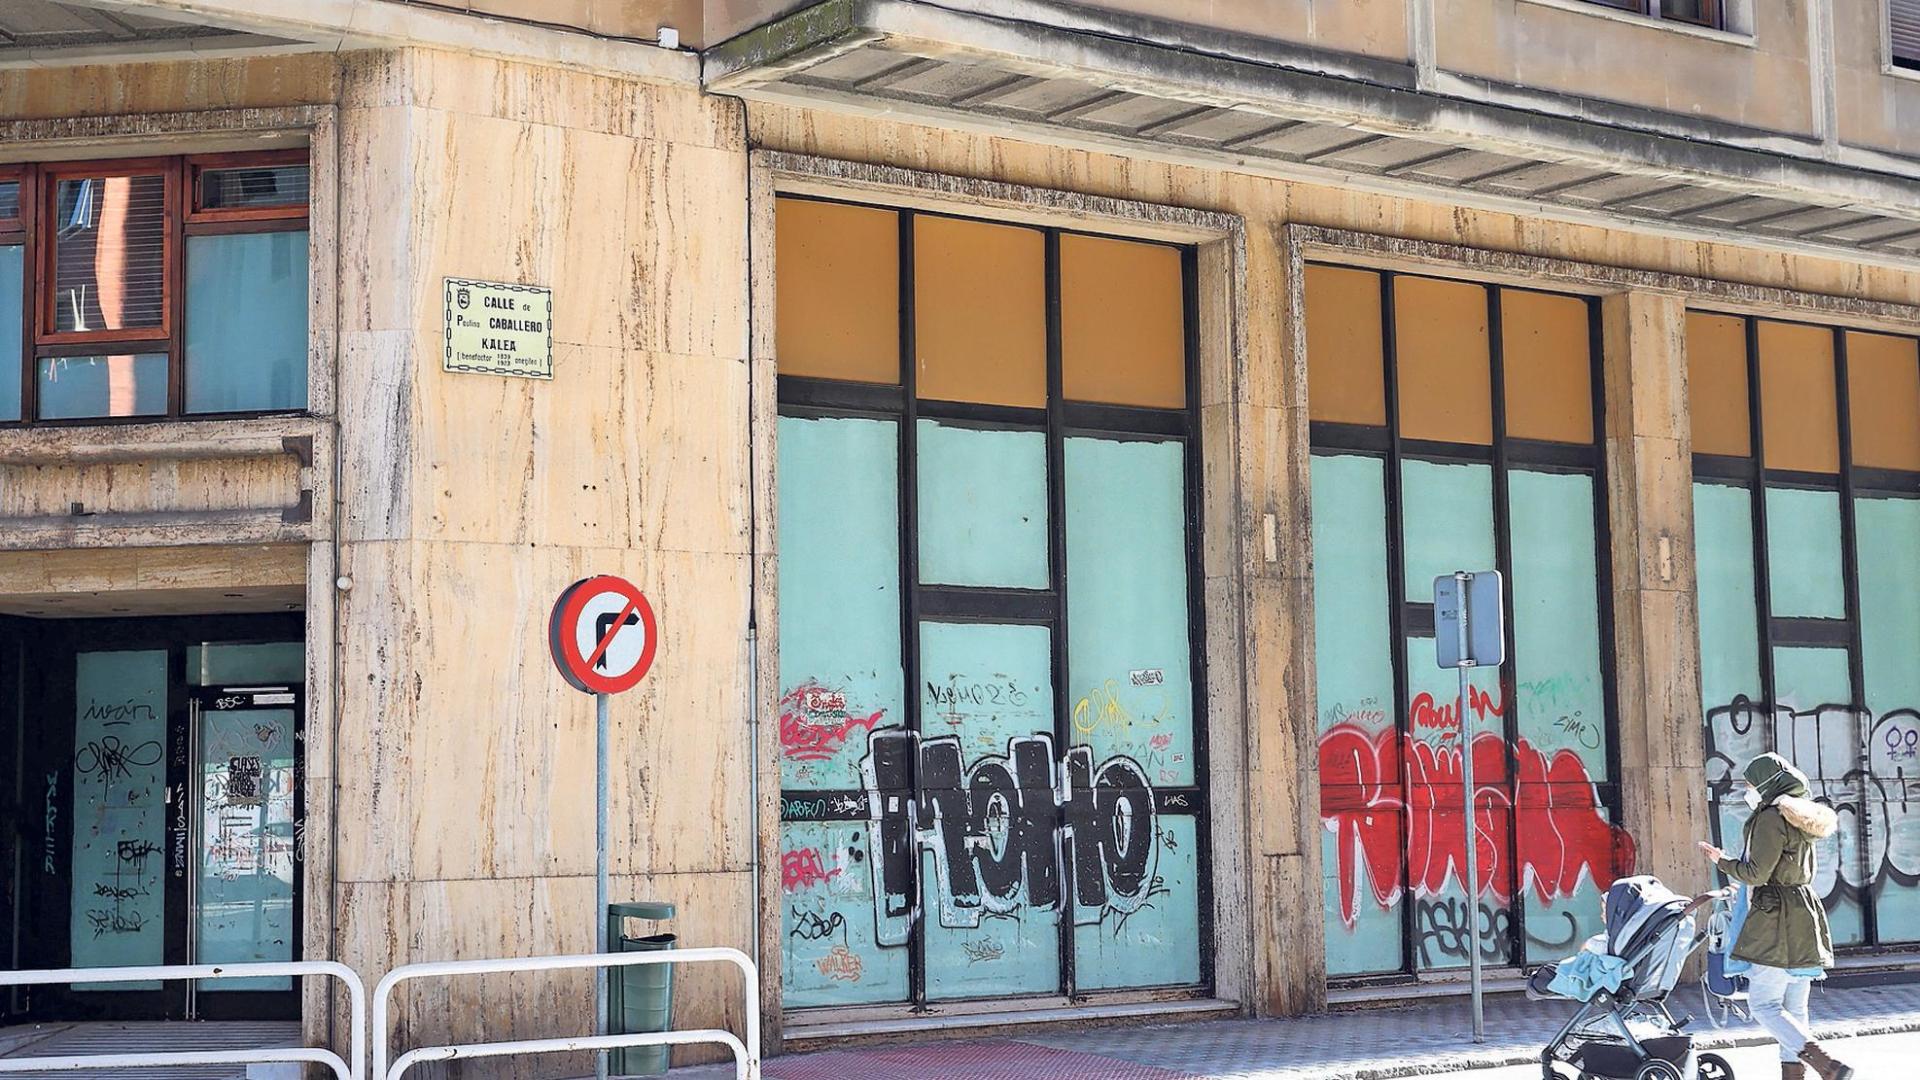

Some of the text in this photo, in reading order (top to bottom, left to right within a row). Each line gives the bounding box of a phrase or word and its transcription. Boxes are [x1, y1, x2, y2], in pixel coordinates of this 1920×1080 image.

[484, 296, 531, 311] CALLE de
[489, 317, 543, 333] CABALLERO
[481, 338, 517, 352] KALEA
